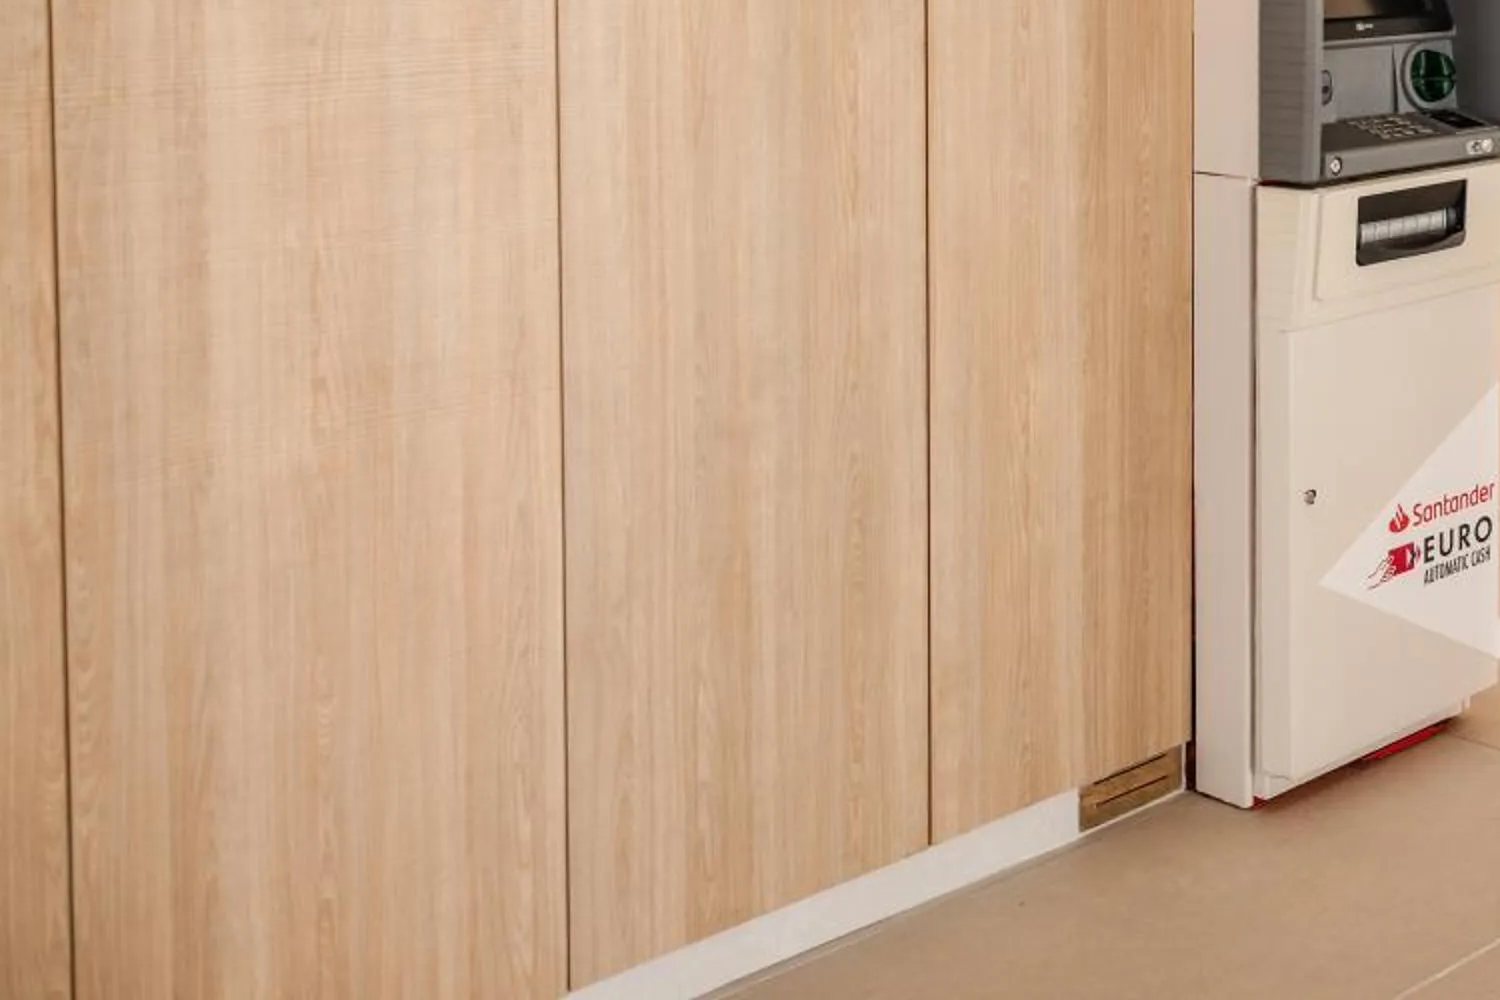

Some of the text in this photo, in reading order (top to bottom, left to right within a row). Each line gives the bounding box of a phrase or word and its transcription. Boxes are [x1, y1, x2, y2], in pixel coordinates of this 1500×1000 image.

[1412, 483, 1495, 527] Santander
[1424, 515, 1493, 564] EURO
[1424, 546, 1491, 584] AUTOMATIC CASH
